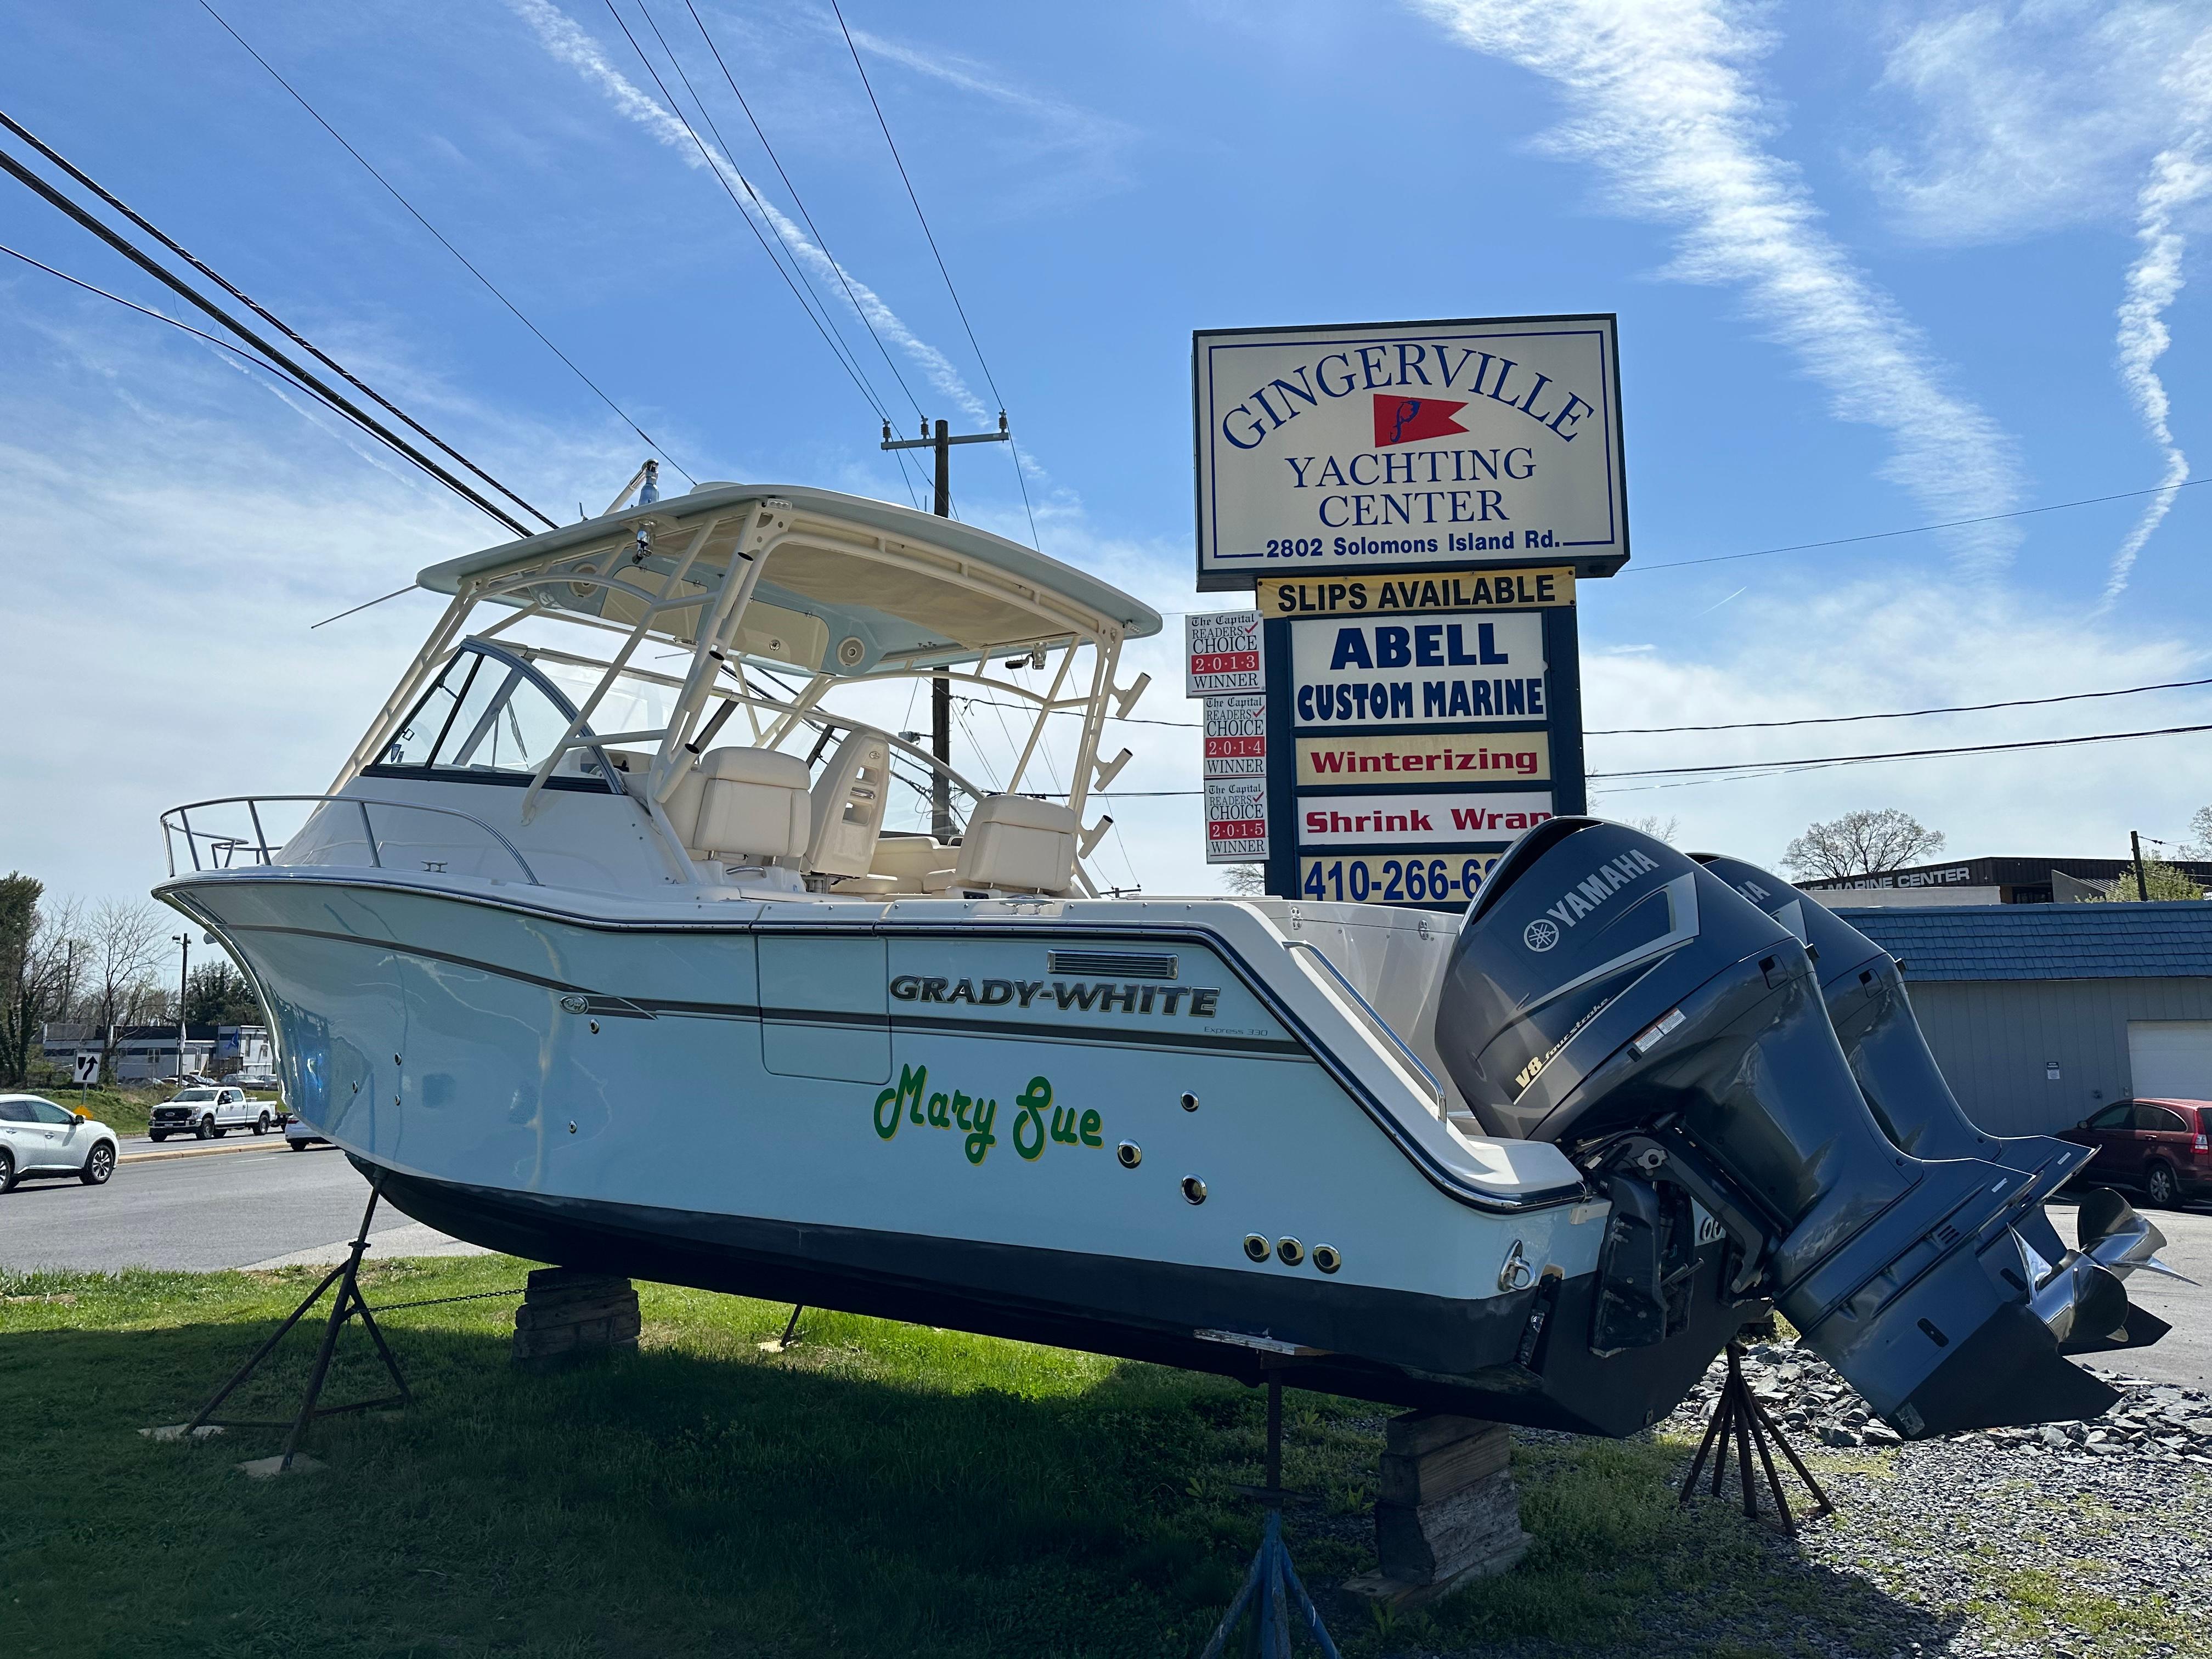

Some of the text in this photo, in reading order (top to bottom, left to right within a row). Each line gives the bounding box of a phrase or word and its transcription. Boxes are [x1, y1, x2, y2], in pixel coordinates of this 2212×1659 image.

[1222, 343, 1595, 450] GINGERVILLE
[1285, 448, 1537, 488] YACHTING
[1319, 490, 1510, 528] CENTER
[1266, 529, 1560, 558] 2802 Solomons Island Rd.
[1278, 574, 1556, 613] SLIPS AVAILABLE
[1192, 613, 1255, 627] The Capital
[1192, 626, 1243, 639] READERS
[1193, 635, 1257, 654] CHOICE
[1329, 623, 1509, 670] ABELL
[1194, 673, 1259, 689] WINNER
[1206, 697, 1262, 708] The Capital
[1297, 678, 1544, 721] CUSTOM MARINE
[1207, 709, 1251, 720] READERS
[1207, 720, 1263, 737] CHOICE
[1207, 759, 1264, 774] WINNER
[1311, 748, 1538, 774] Winterizing
[1209, 783, 1261, 794] The Capital
[1210, 795, 1252, 806] READERS
[1210, 804, 1263, 820] CHOICE
[1306, 810, 1434, 833] Shrink
[1211, 839, 1265, 854] WINNER
[1898, 867, 1970, 887] CENTER
[1547, 849, 1660, 928] YAMAHA
[889, 974, 1221, 1018] GRADY-WHITE
[1515, 1057, 1542, 1088] V8
[873, 1063, 1104, 1166] Mary Sue
